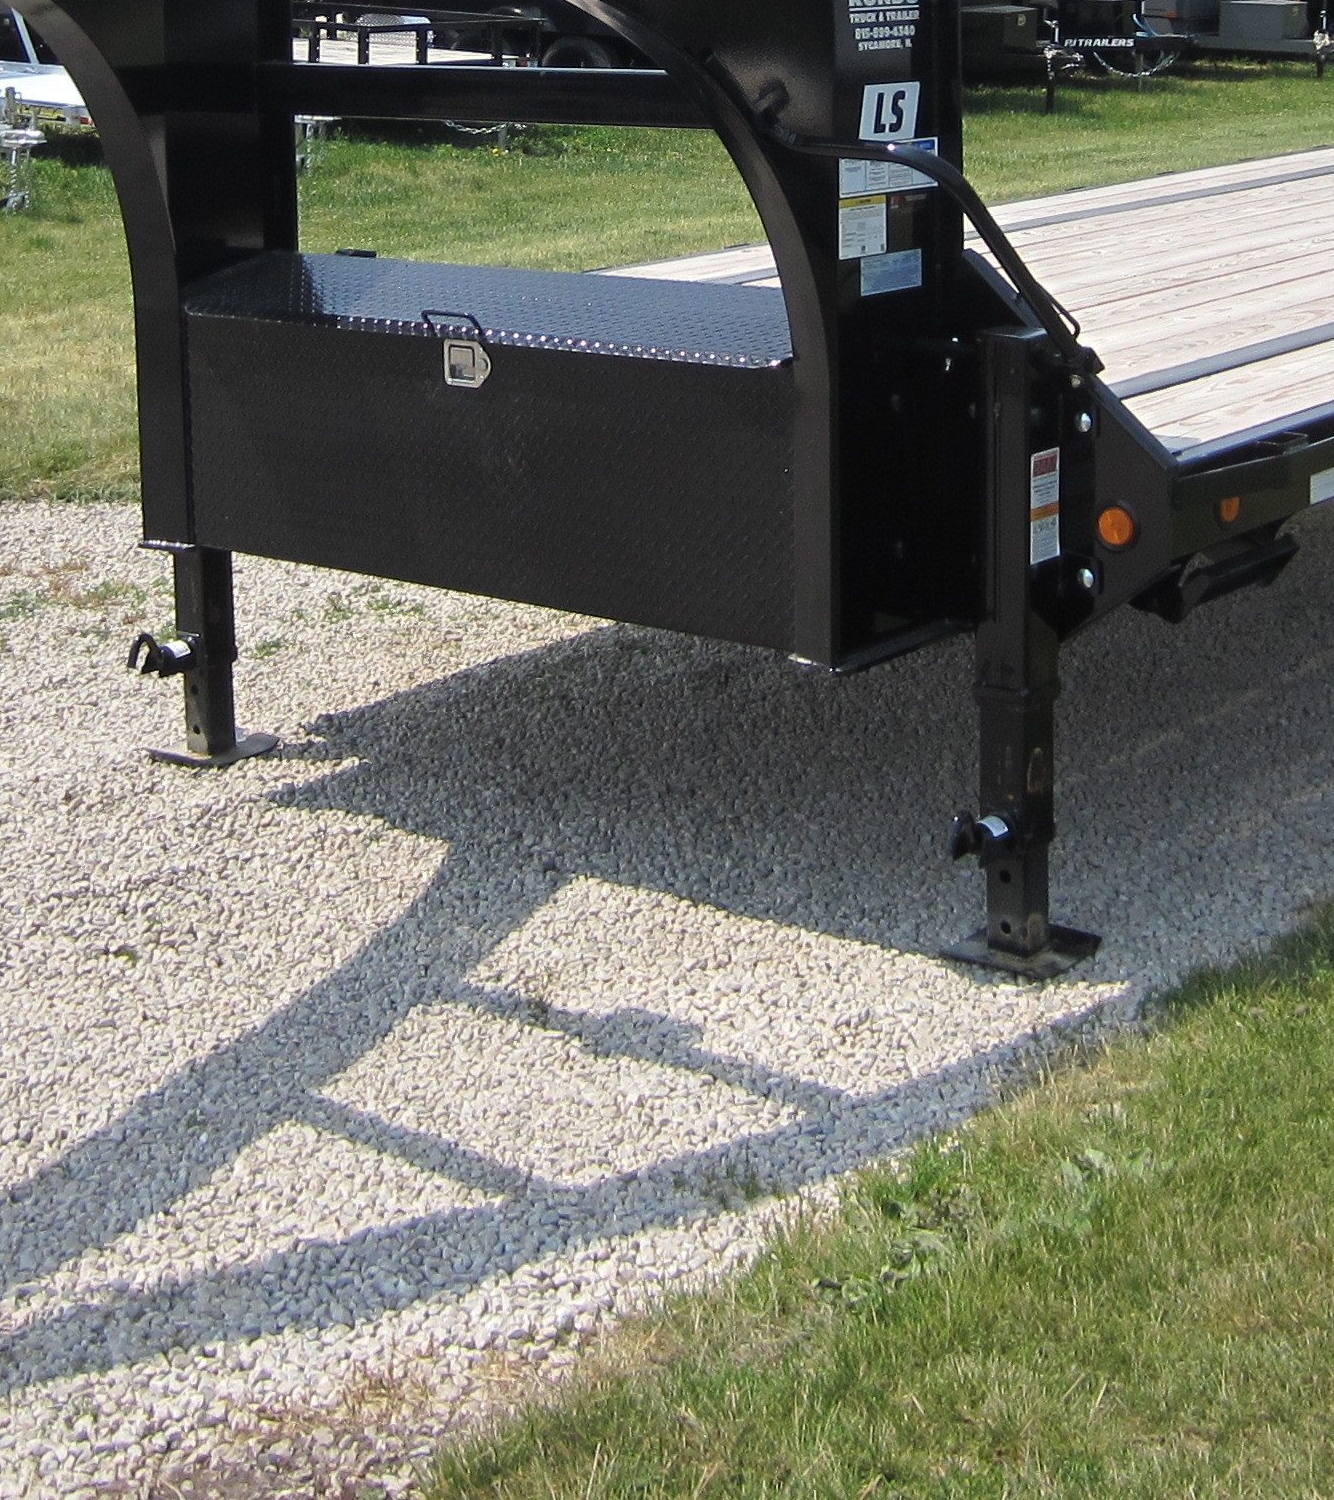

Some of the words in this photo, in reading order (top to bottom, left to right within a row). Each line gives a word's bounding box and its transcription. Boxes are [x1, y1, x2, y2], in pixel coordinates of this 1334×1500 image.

[849, 12, 877, 24] TRUCK
[878, 11, 884, 22] &
[885, 10, 920, 21] TRAILER
[1078, 38, 1134, 47] TRAILERS
[873, 89, 906, 135] LS
